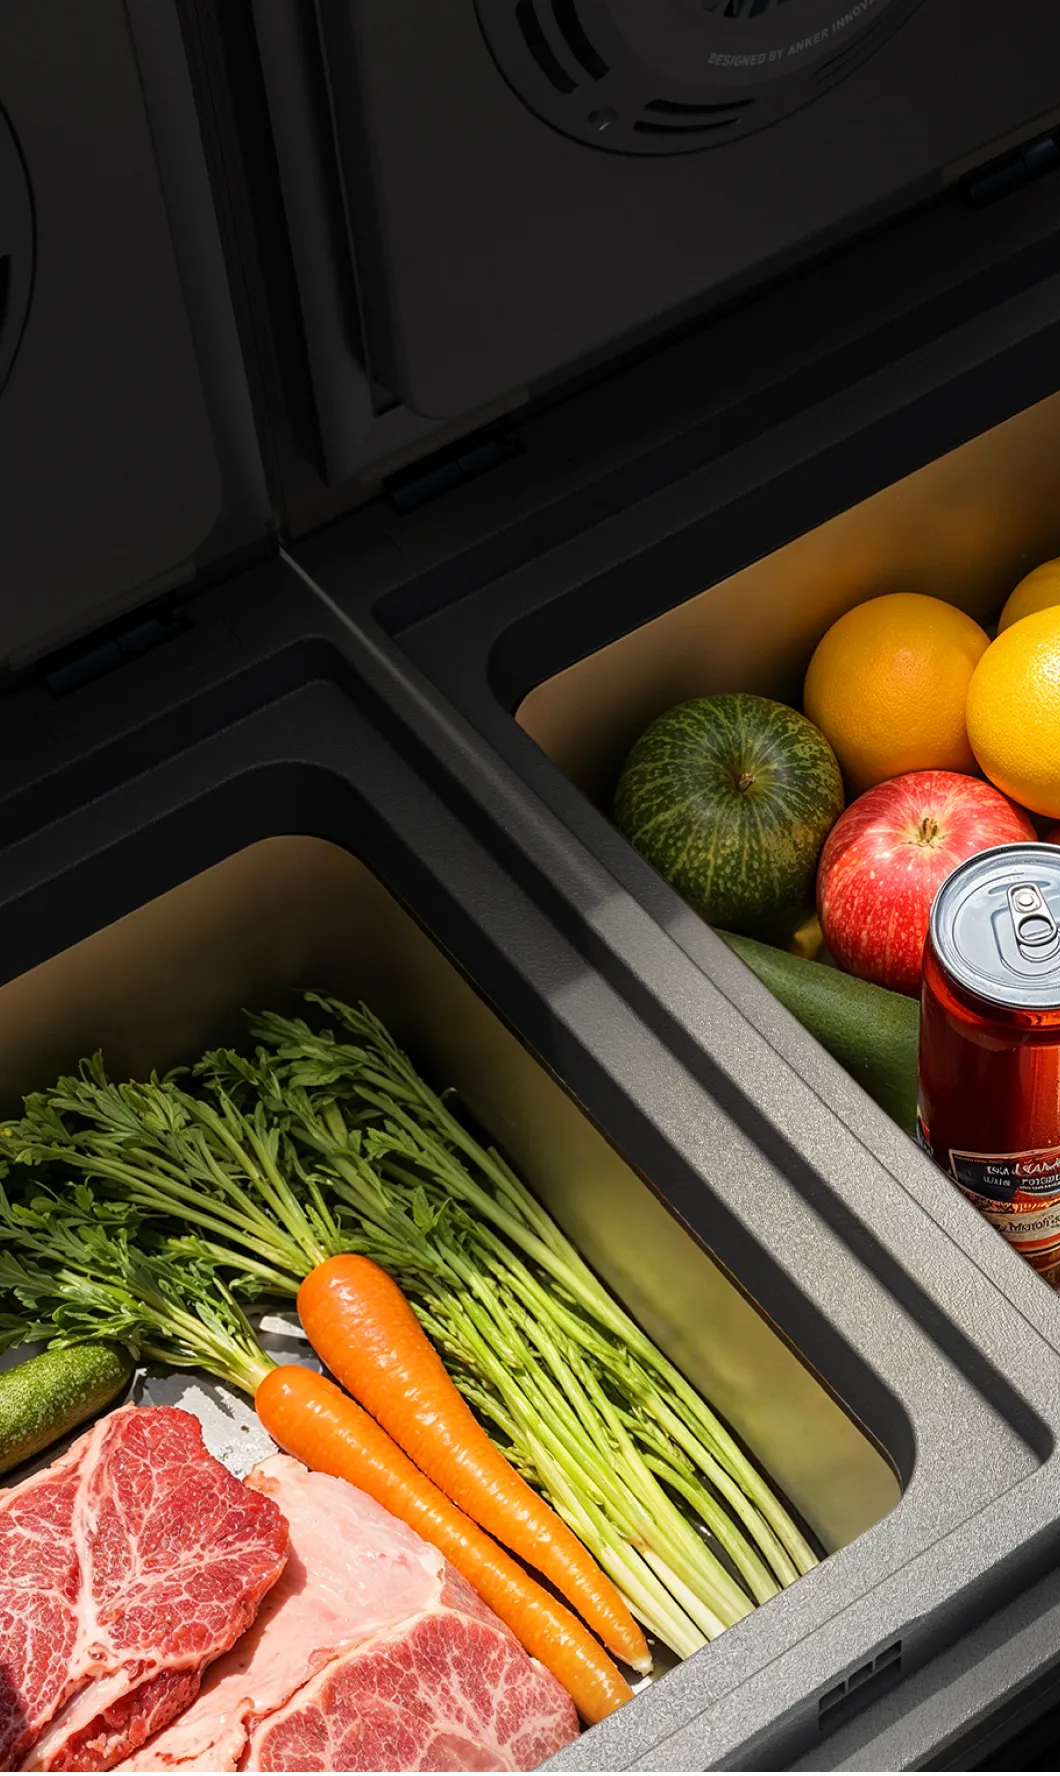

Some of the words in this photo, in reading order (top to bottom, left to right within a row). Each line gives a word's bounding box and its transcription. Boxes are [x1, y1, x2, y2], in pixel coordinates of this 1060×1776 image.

[708, 53, 766, 67] DESIGNED
[768, 47, 786, 62] BY
[787, 28, 829, 56] ANKER
